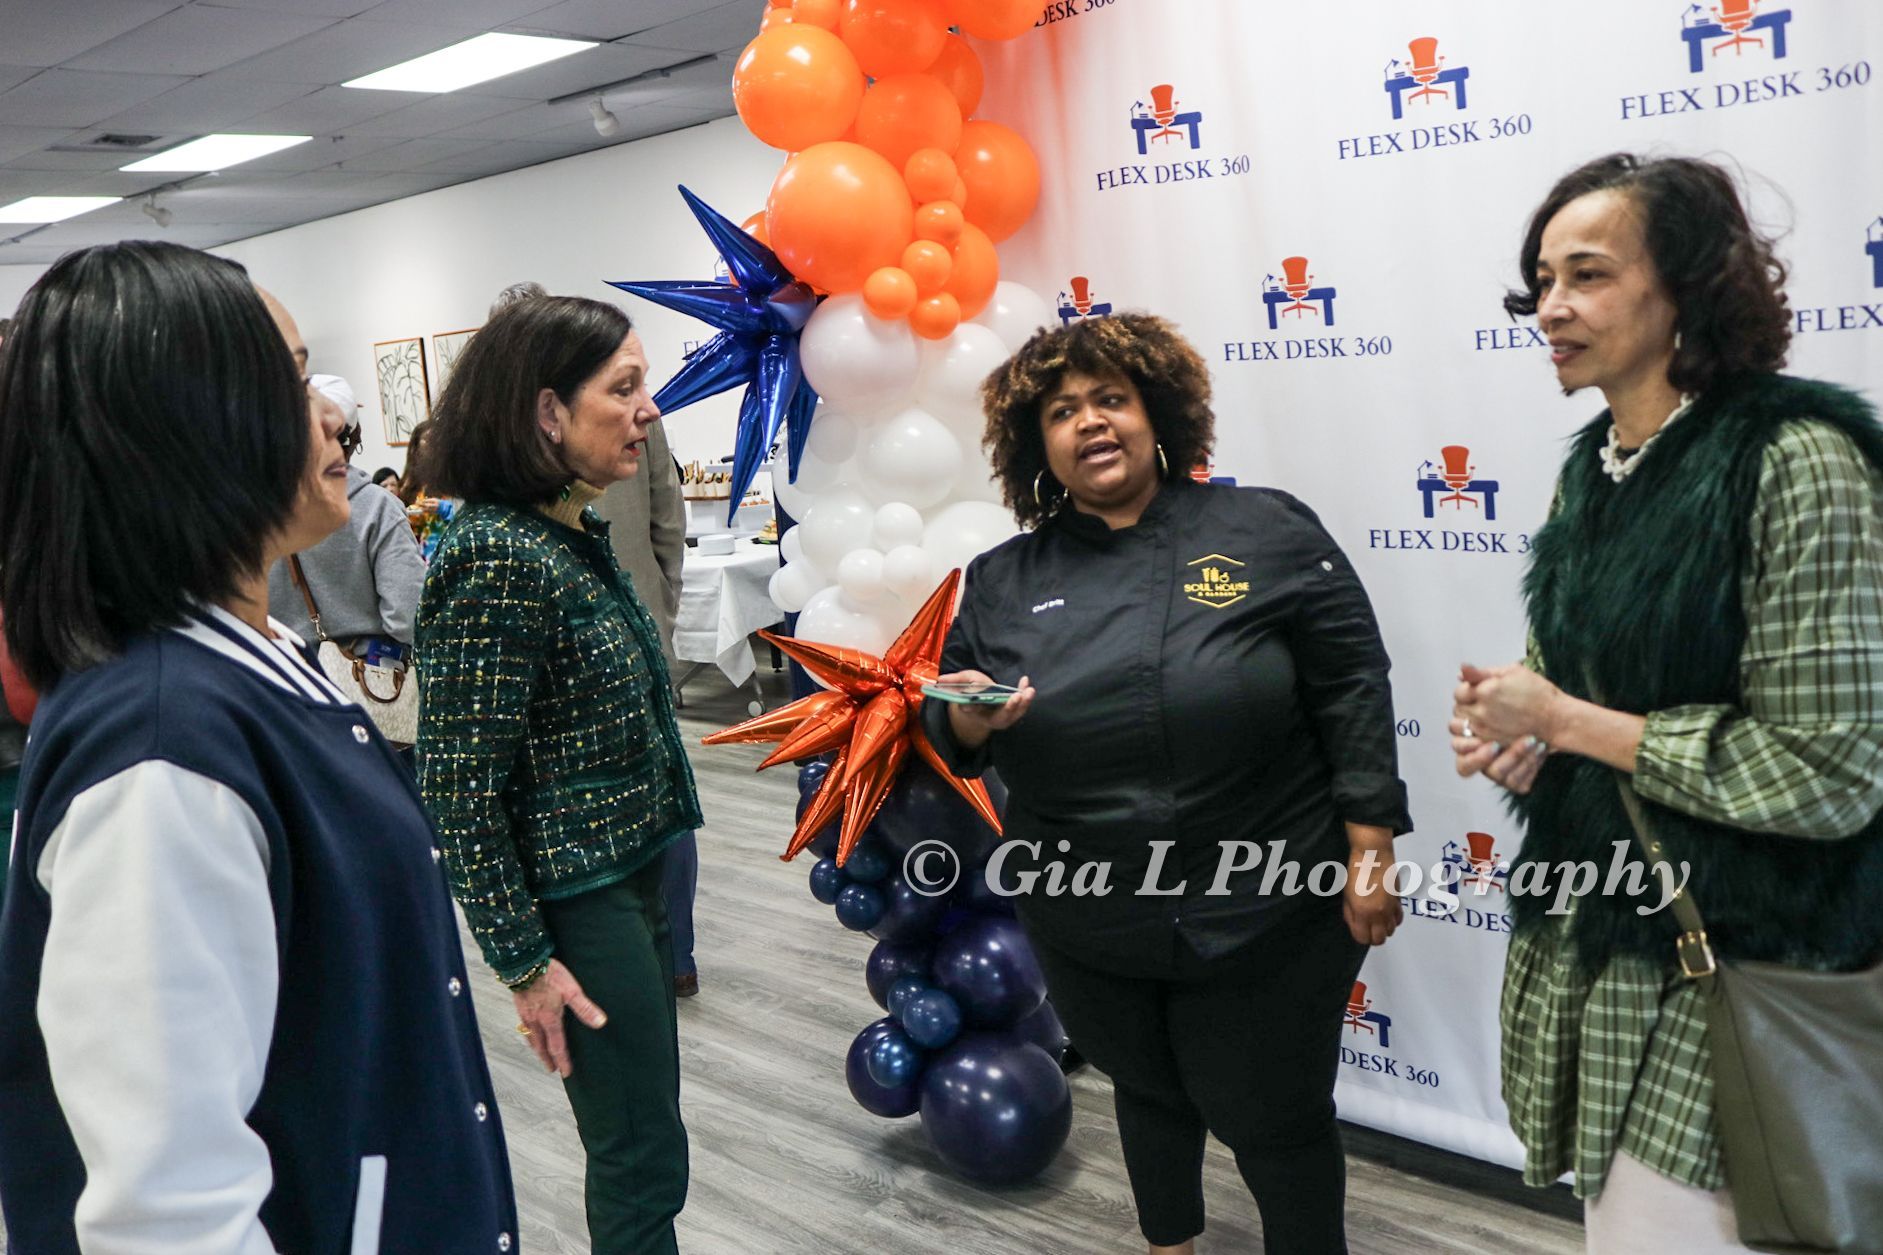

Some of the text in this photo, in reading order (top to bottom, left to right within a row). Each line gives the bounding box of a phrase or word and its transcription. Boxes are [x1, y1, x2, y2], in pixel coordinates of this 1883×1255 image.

[1620, 60, 1871, 120] FLEX DESK 360
[1338, 113, 1532, 160] FLEX DESK 360
[1096, 154, 1250, 191] FLEX DESK 360
[1795, 303, 1883, 333] FLEX
[1224, 335, 1392, 361] FLEX DESK 360
[1475, 326, 1548, 350] FLEX
[1369, 529, 1434, 550] FLEX
[1441, 531, 1509, 553] DESK
[1396, 719, 1420, 738] 60
[1465, 908, 1513, 934] DES
[1341, 1046, 1439, 1088] DESK 360
